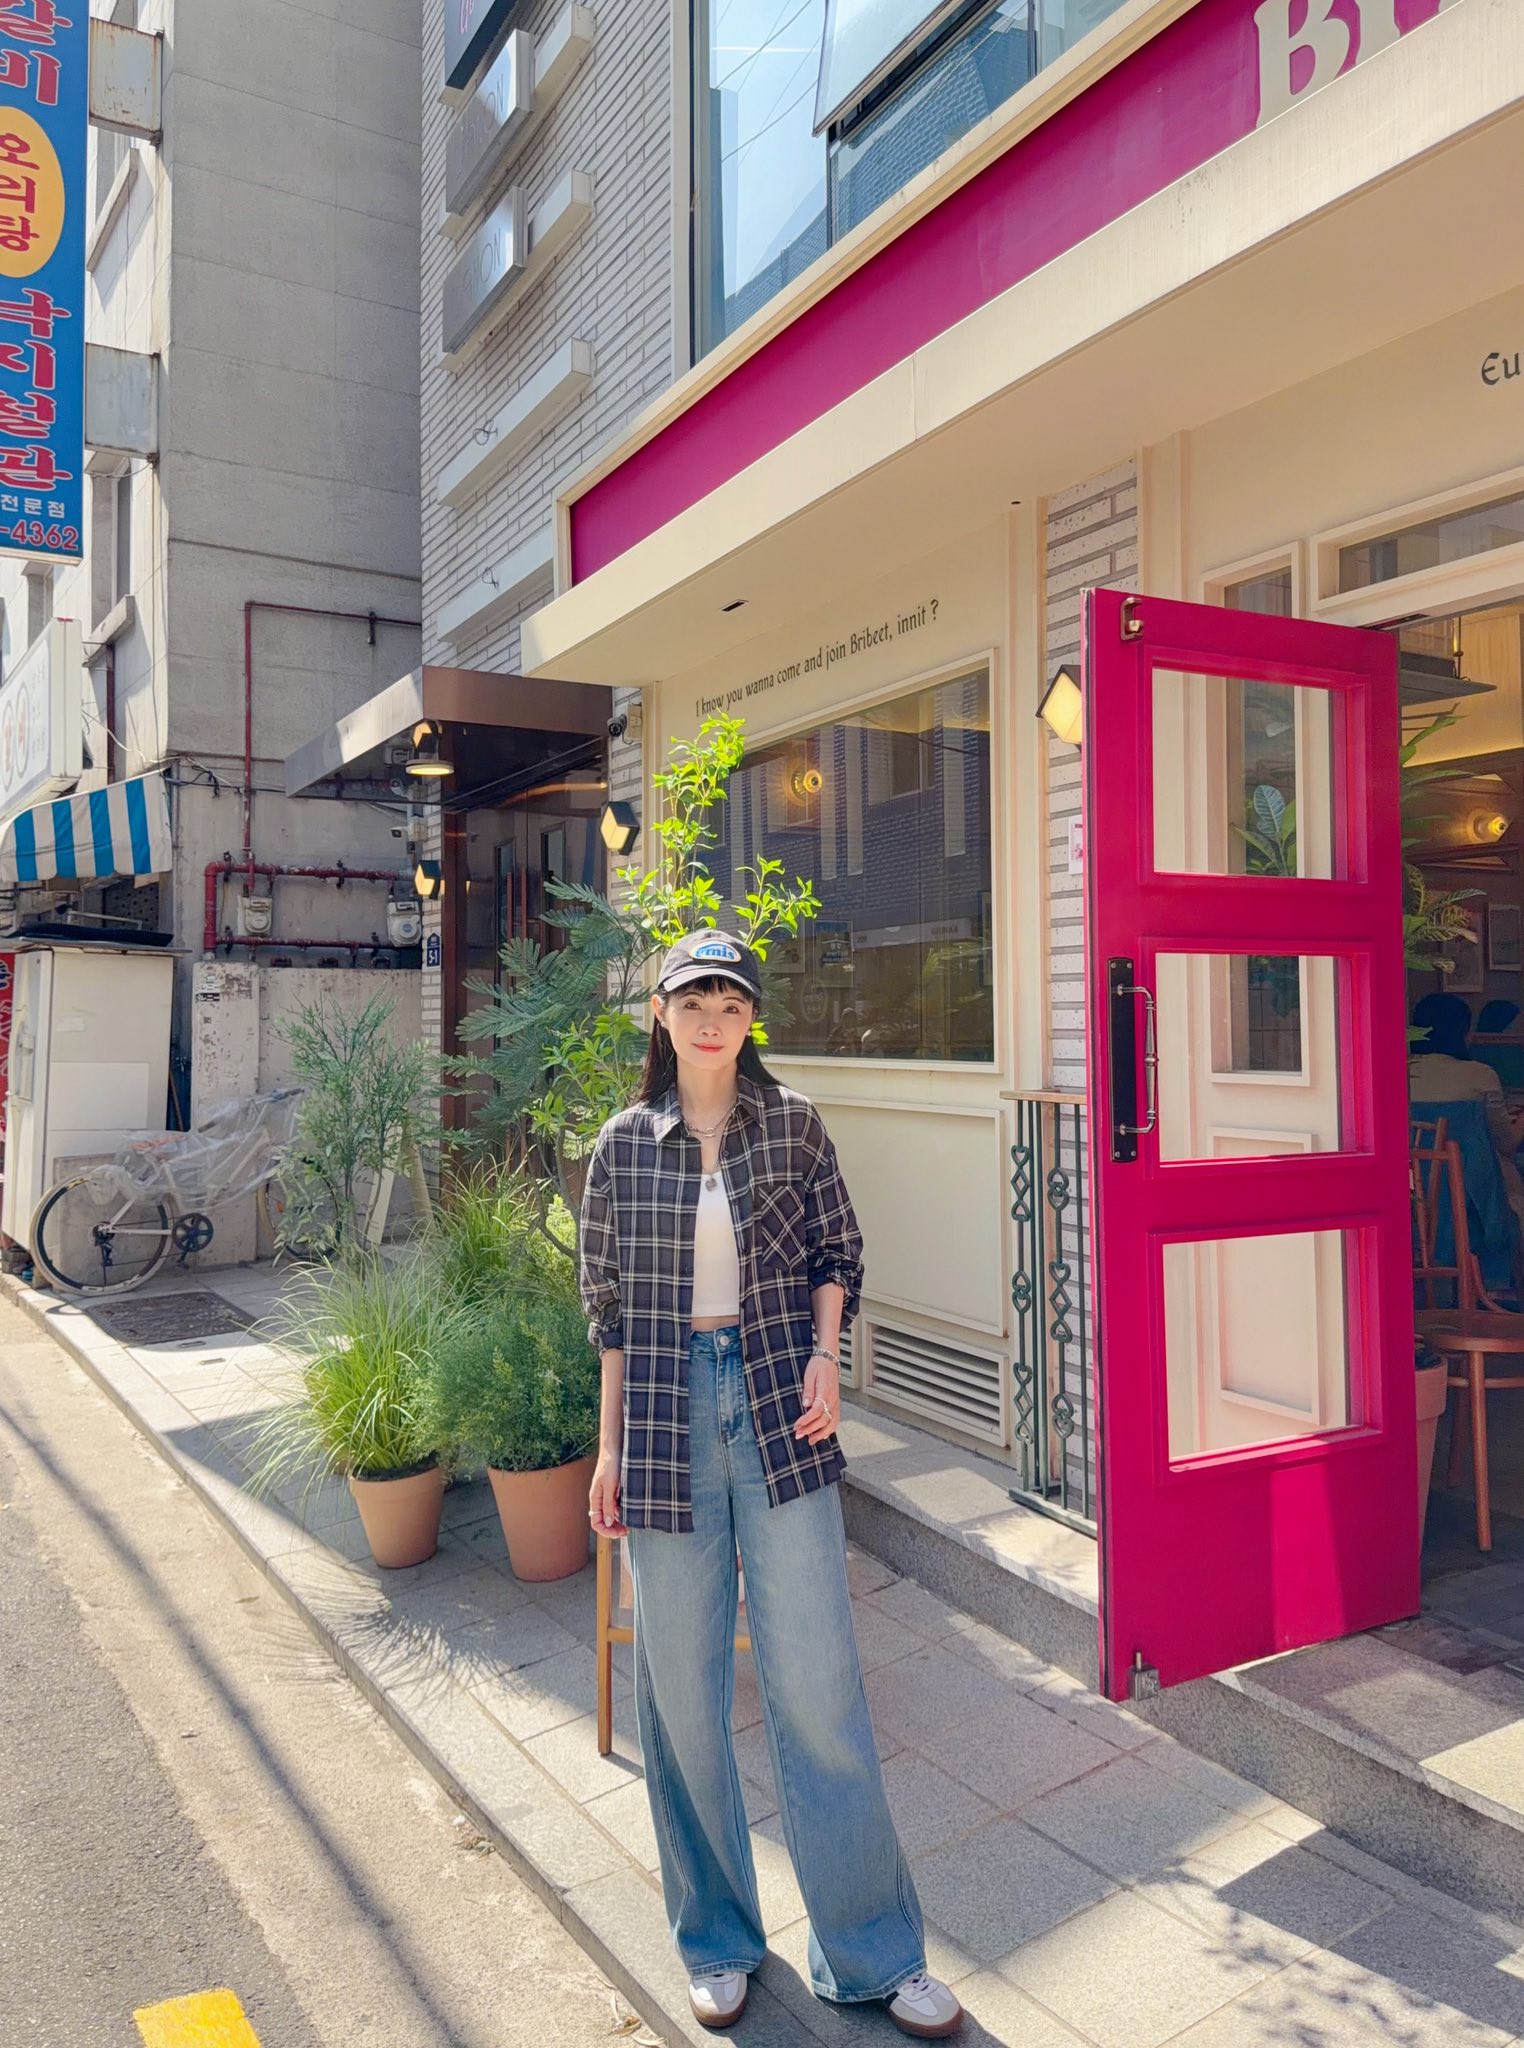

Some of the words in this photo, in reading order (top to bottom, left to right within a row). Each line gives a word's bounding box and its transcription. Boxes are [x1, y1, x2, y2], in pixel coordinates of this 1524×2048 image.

[695, 700, 700, 717] I
[701, 695, 724, 715] know
[726, 688, 743, 711] you
[745, 674, 774, 697] wanna
[777, 663, 800, 684] come
[804, 647, 822, 673] and
[826, 641, 846, 670] join
